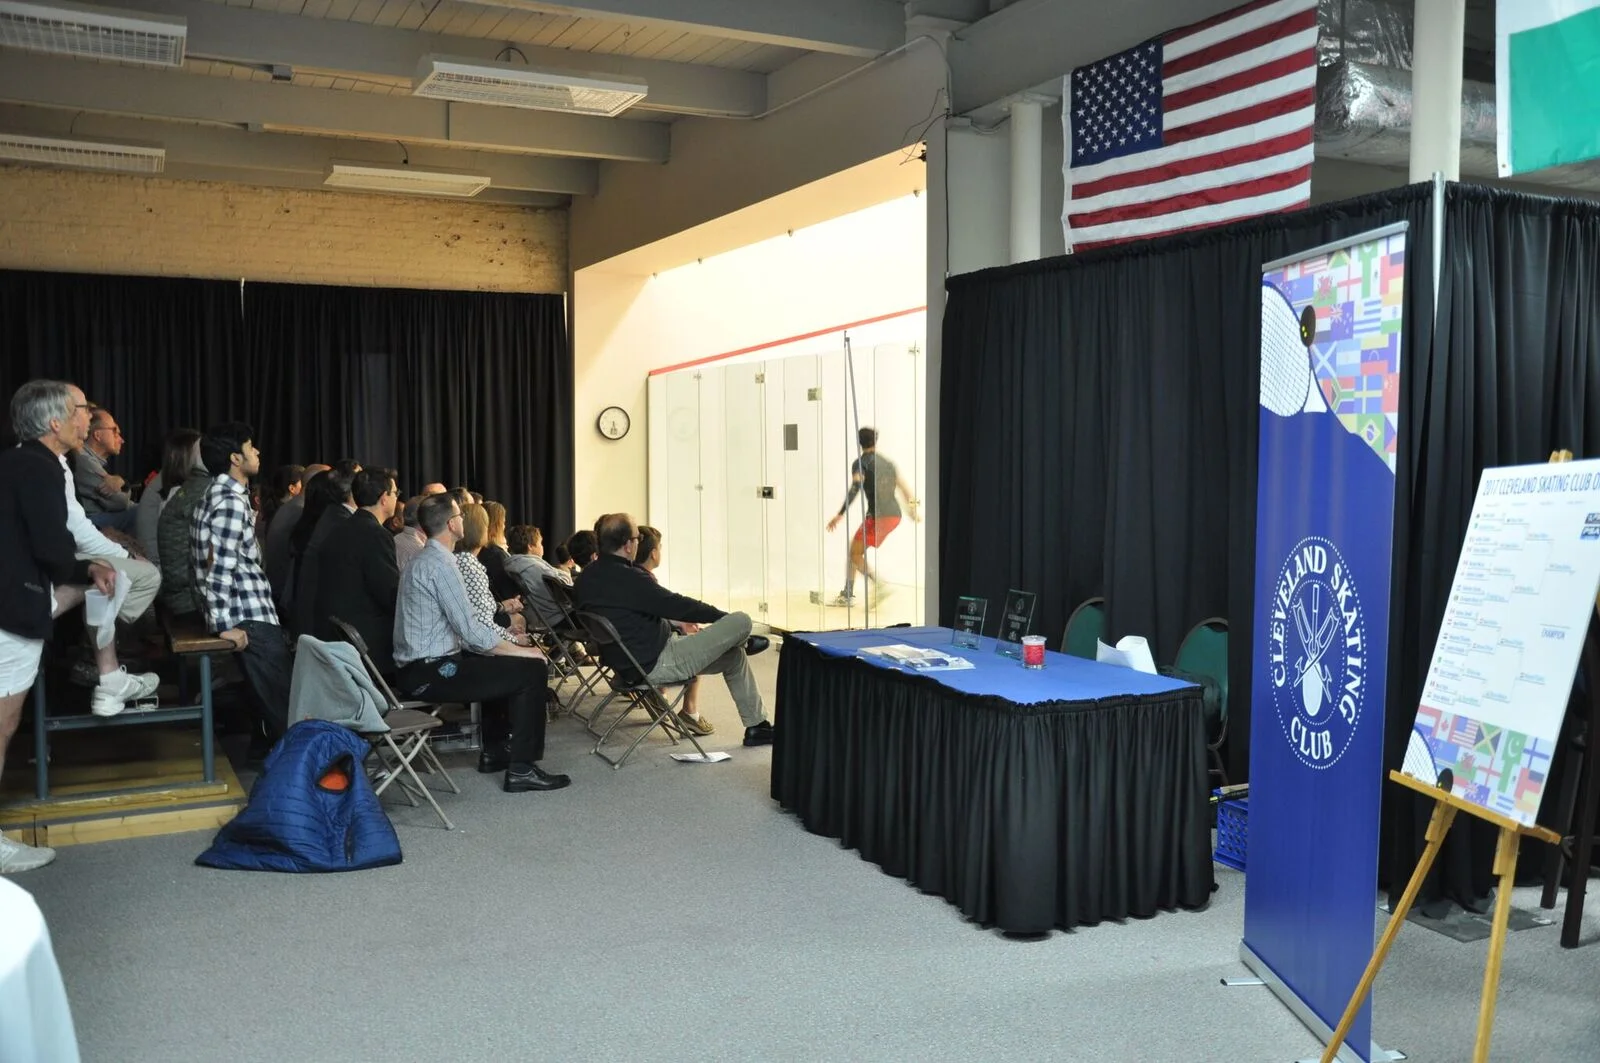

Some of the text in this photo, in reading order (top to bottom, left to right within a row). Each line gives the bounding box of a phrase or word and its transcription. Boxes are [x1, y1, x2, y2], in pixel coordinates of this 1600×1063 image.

[1482, 479, 1500, 496] 2017
[1499, 476, 1538, 495] CLEVELAND
[1537, 474, 1570, 493] SKATING
[1570, 472, 1593, 492] CLUB
[1273, 545, 1362, 725] CLEVELAND SKATING
[1291, 716, 1332, 760] CLUB
